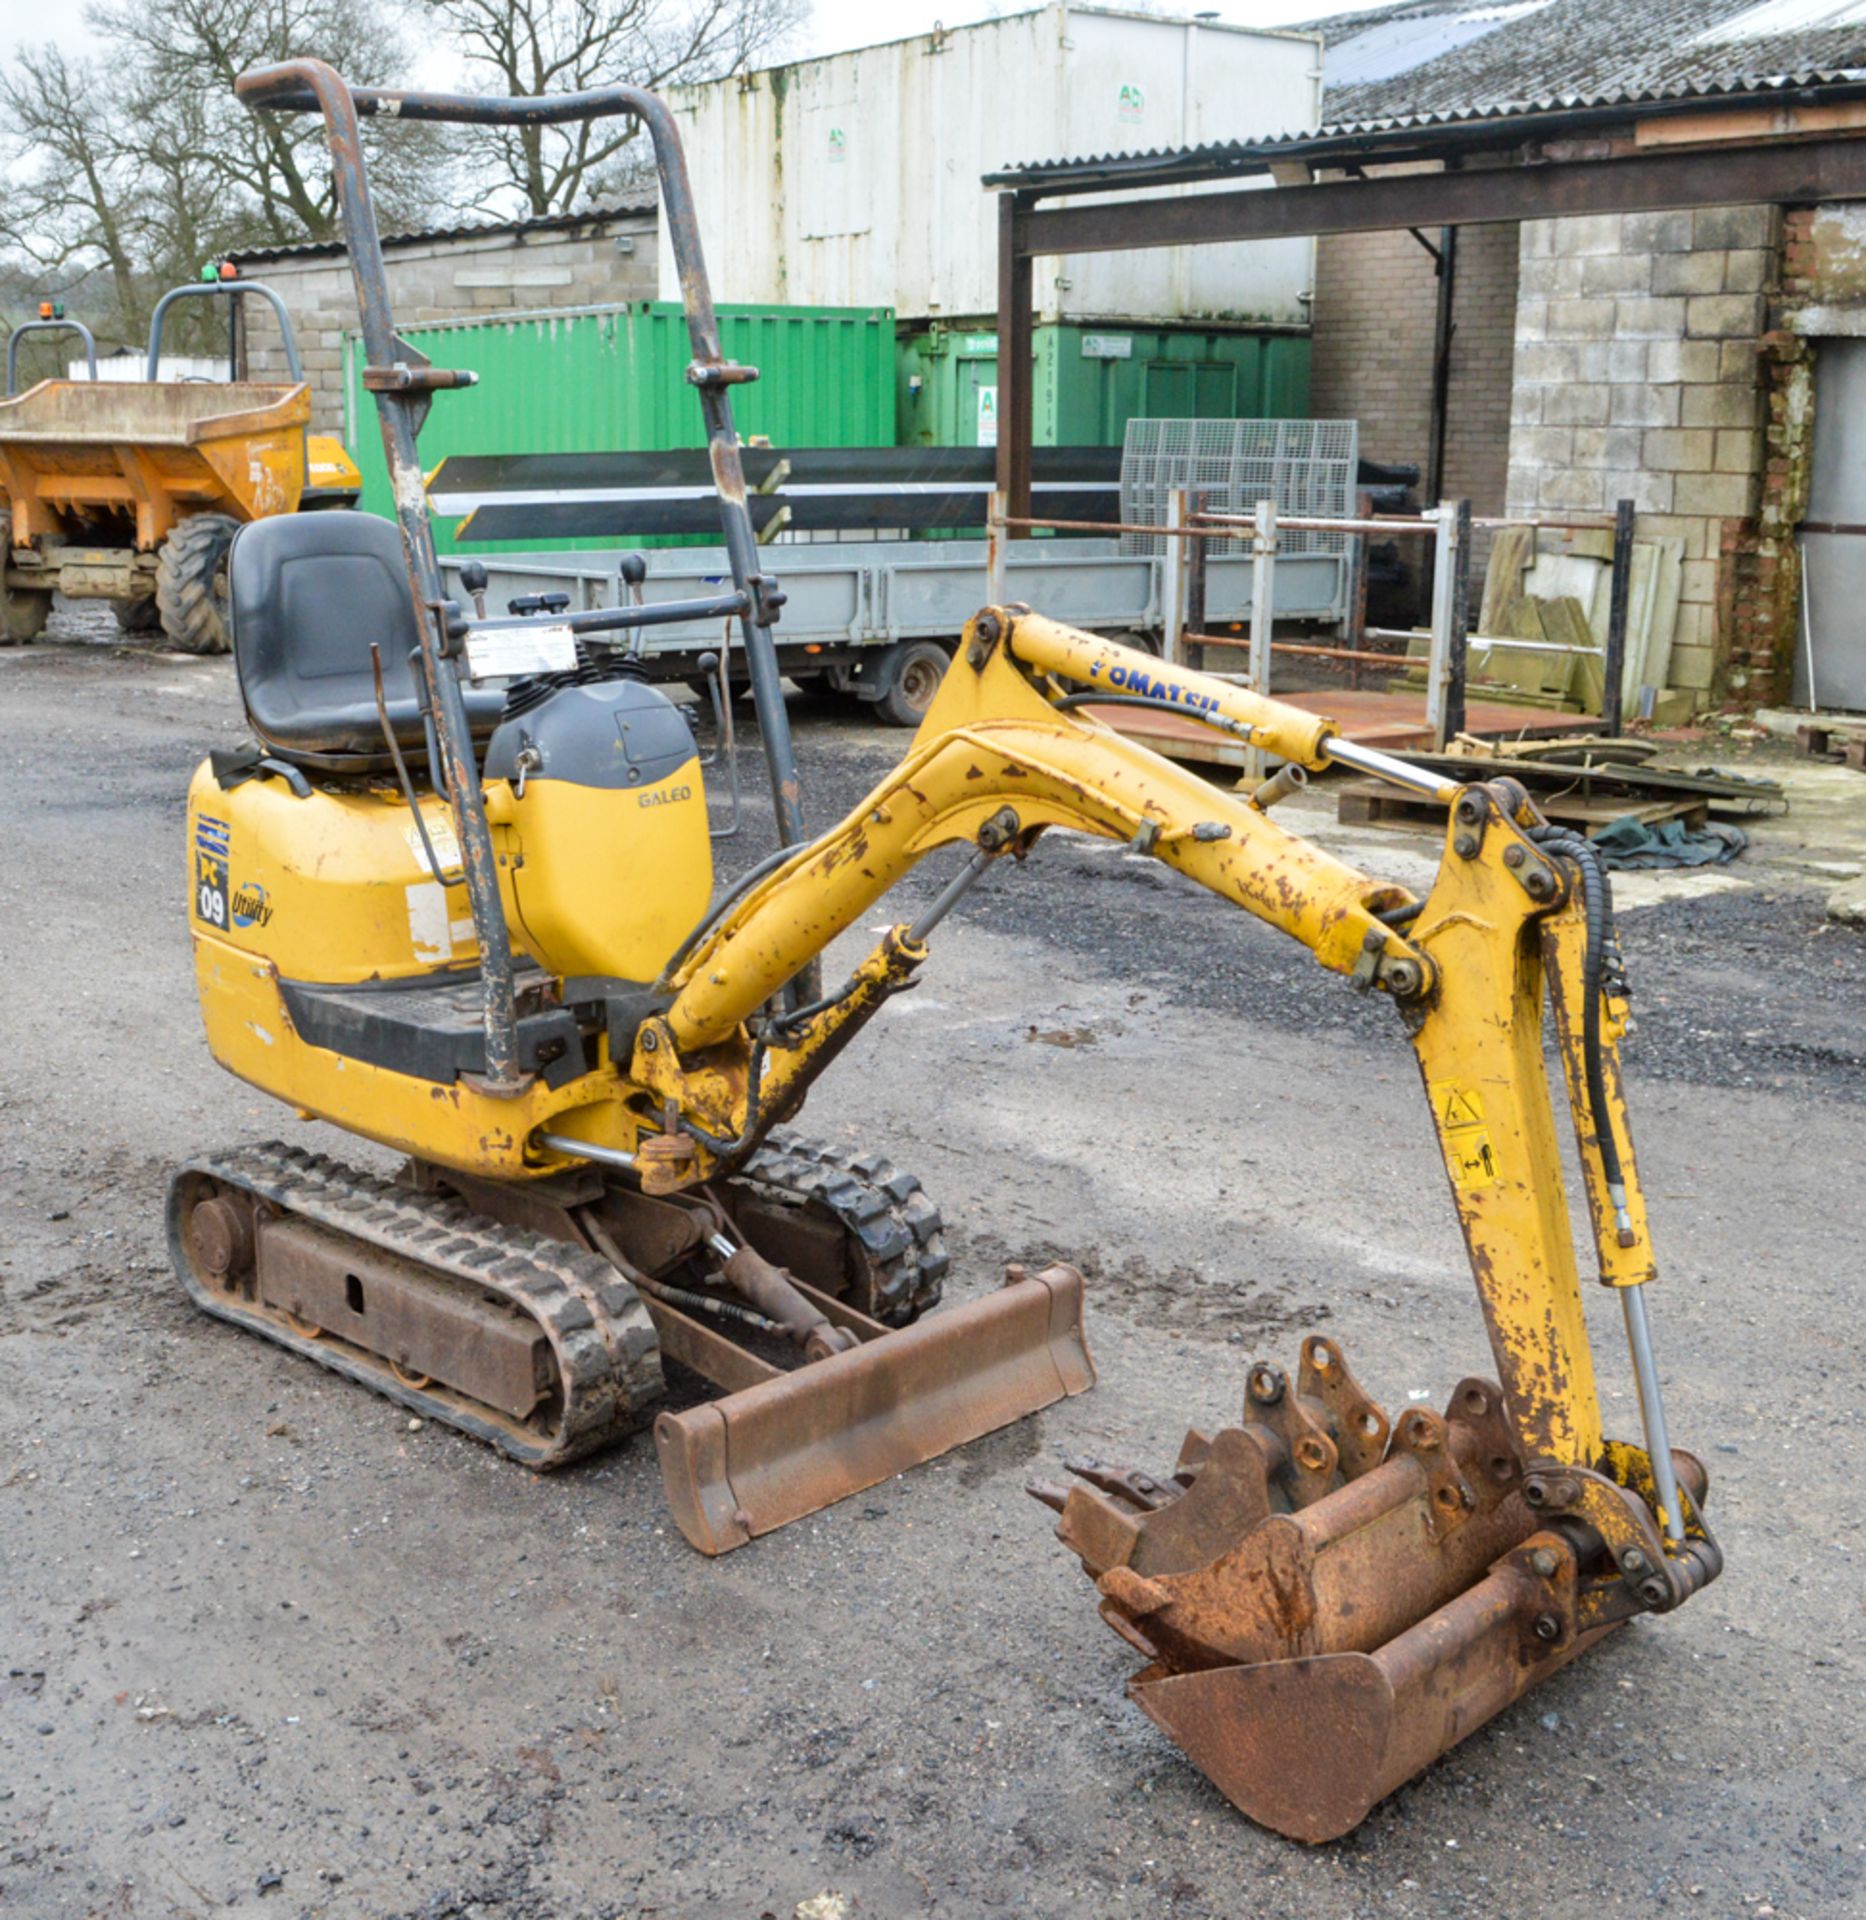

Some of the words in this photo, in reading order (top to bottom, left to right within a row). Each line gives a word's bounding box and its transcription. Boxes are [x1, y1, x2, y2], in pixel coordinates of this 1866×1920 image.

[639, 786, 691, 807] GALEO
[201, 885, 224, 924] 09
[231, 890, 274, 928] Utility
